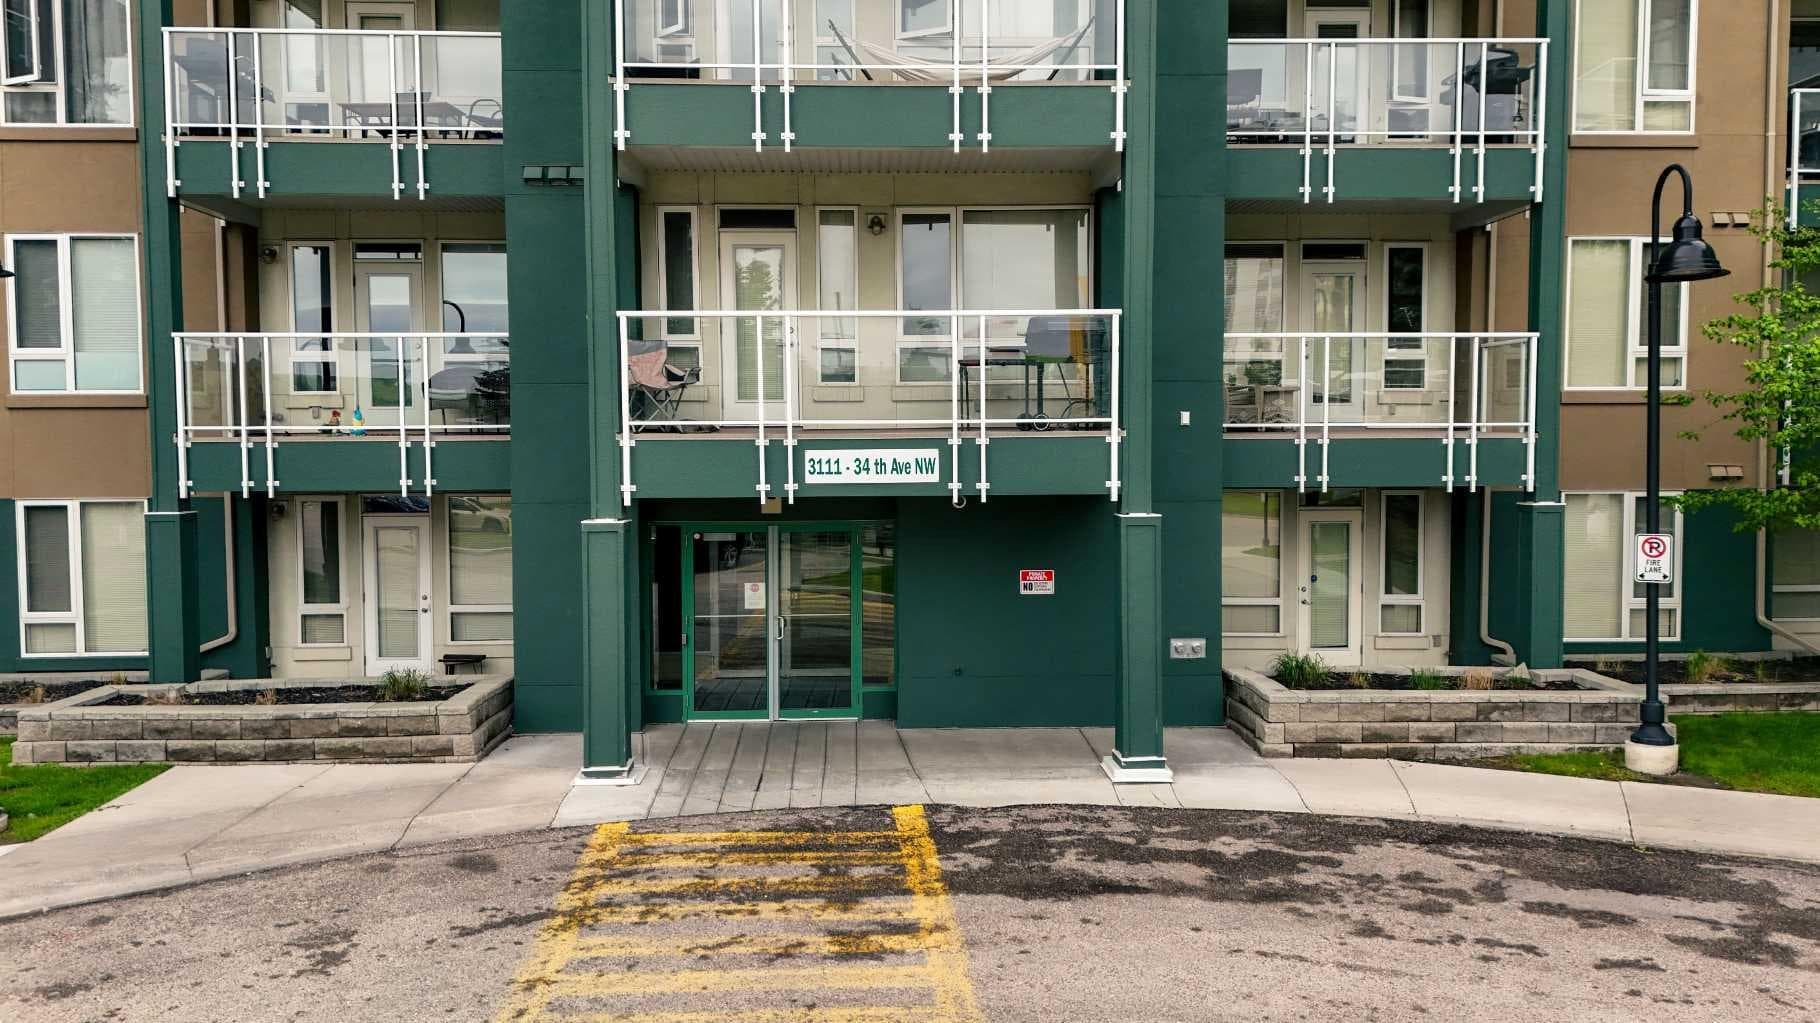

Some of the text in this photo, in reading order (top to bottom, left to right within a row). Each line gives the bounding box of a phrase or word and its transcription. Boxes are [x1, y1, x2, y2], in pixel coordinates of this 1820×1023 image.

[808, 457, 842, 475] 3111
[853, 457, 870, 475] 34
[874, 457, 887, 475] th
[890, 457, 912, 475] Ave
[915, 457, 936, 475] NW
[1023, 582, 1033, 591] NO
